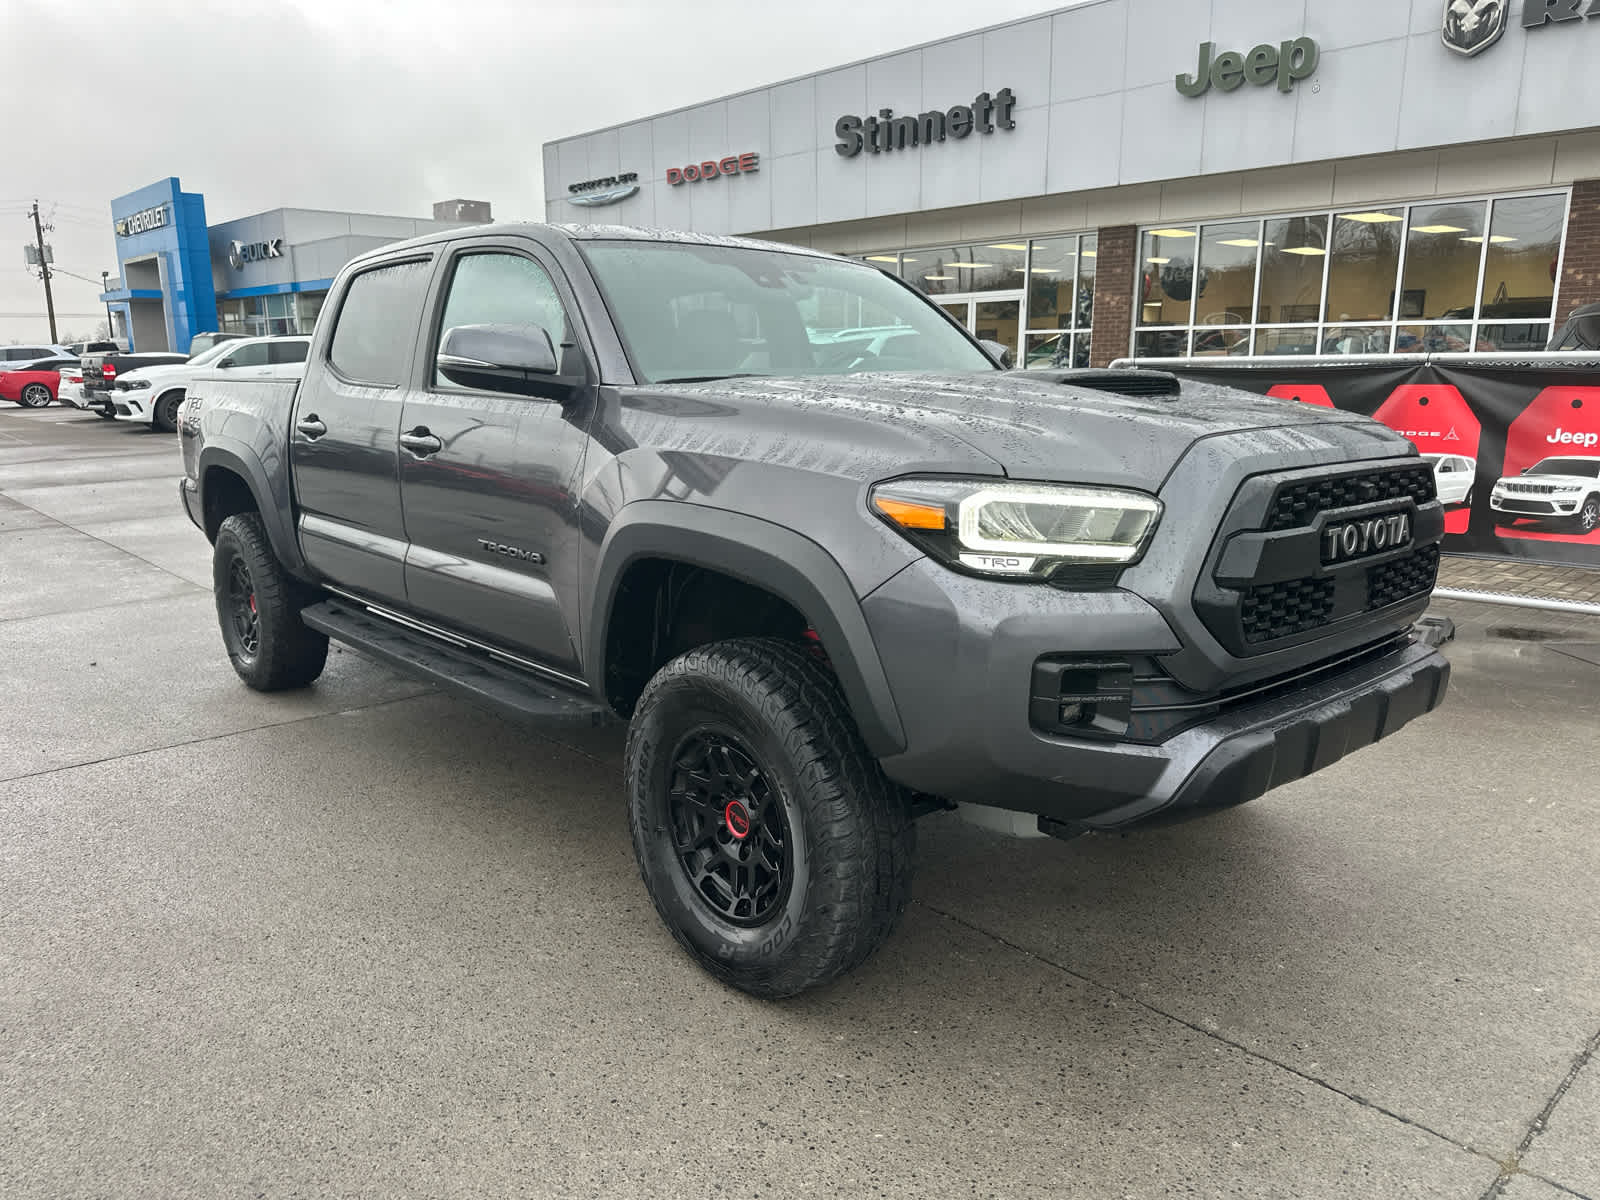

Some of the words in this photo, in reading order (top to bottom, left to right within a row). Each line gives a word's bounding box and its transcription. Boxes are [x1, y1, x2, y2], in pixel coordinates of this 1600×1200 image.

[1175, 36, 1320, 97] Jeep
[835, 88, 1016, 158] Stinnett
[666, 152, 759, 187] DODGE
[128, 206, 168, 235] CHEVROLET
[241, 239, 284, 264] BUICK
[1546, 427, 1598, 448] Jeep
[1327, 512, 1410, 560] TOYOTA
[477, 538, 546, 564] TACOMA
[977, 556, 1020, 568] TRD
[730, 810, 749, 830] TRD
